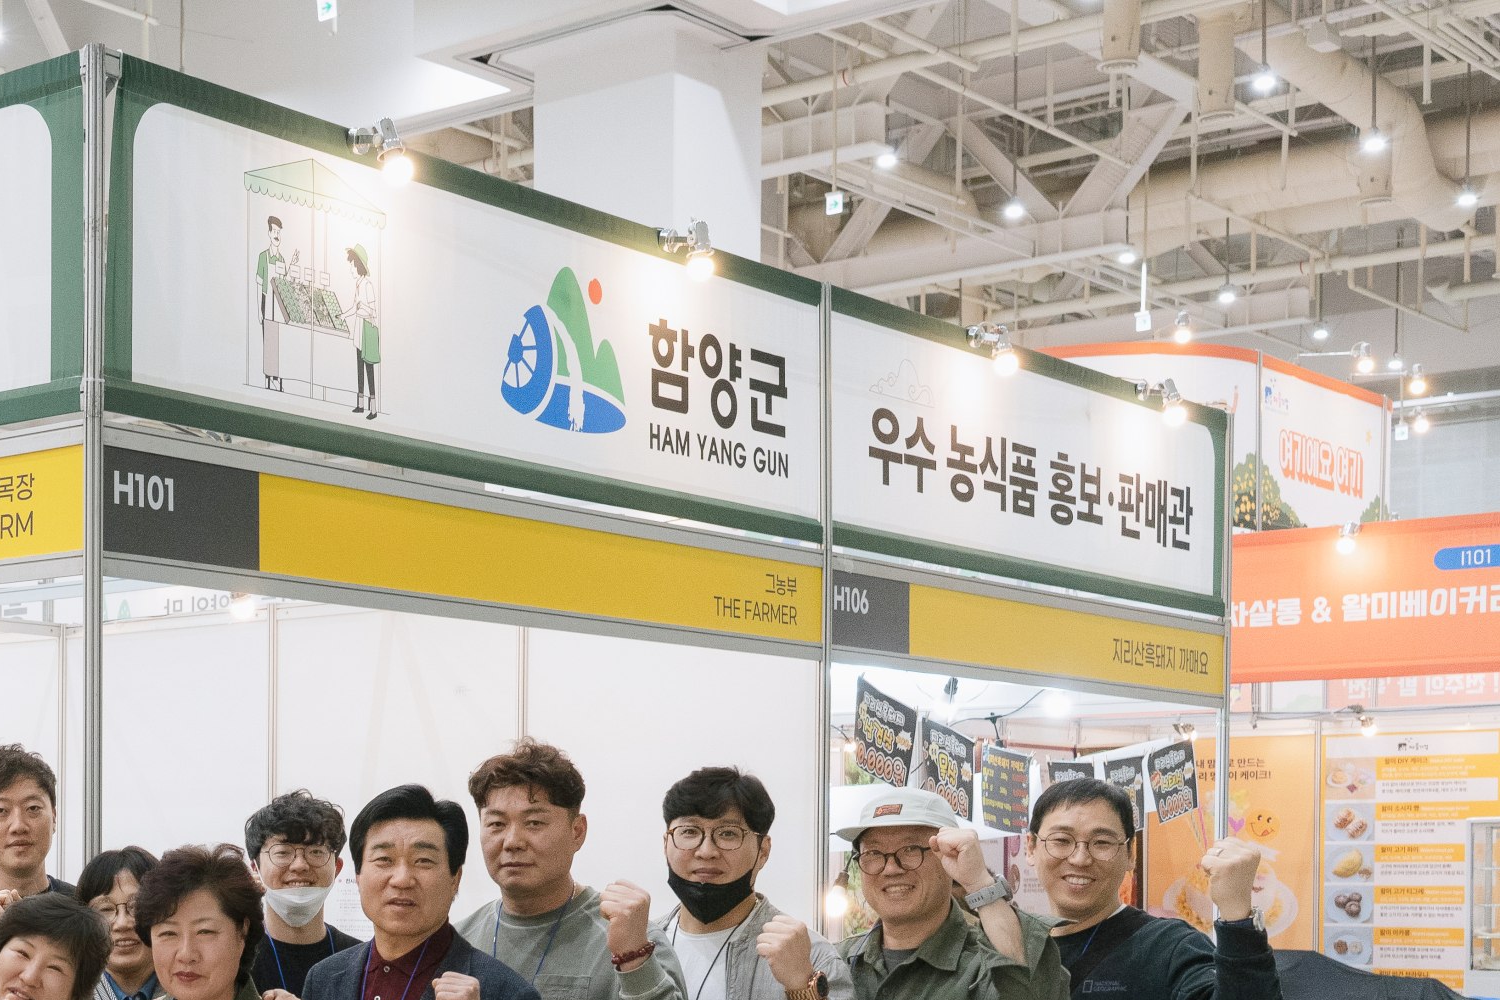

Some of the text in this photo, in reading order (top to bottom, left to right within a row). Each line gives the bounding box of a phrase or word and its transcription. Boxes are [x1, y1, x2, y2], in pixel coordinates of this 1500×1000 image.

[648, 318, 788, 439] 함양군
[649, 422, 789, 479] HAM YANG GUN
[868, 407, 937, 494] 우수
[946, 424, 1039, 518] 농식품
[113, 470, 175, 512] H101
[765, 573, 797, 597] 그농부
[833, 584, 869, 615] H106
[714, 596, 797, 626] THE FARMER
[1311, 596, 1332, 623] &
[1112, 637, 1209, 676] 지리산흑돼지 까매요
